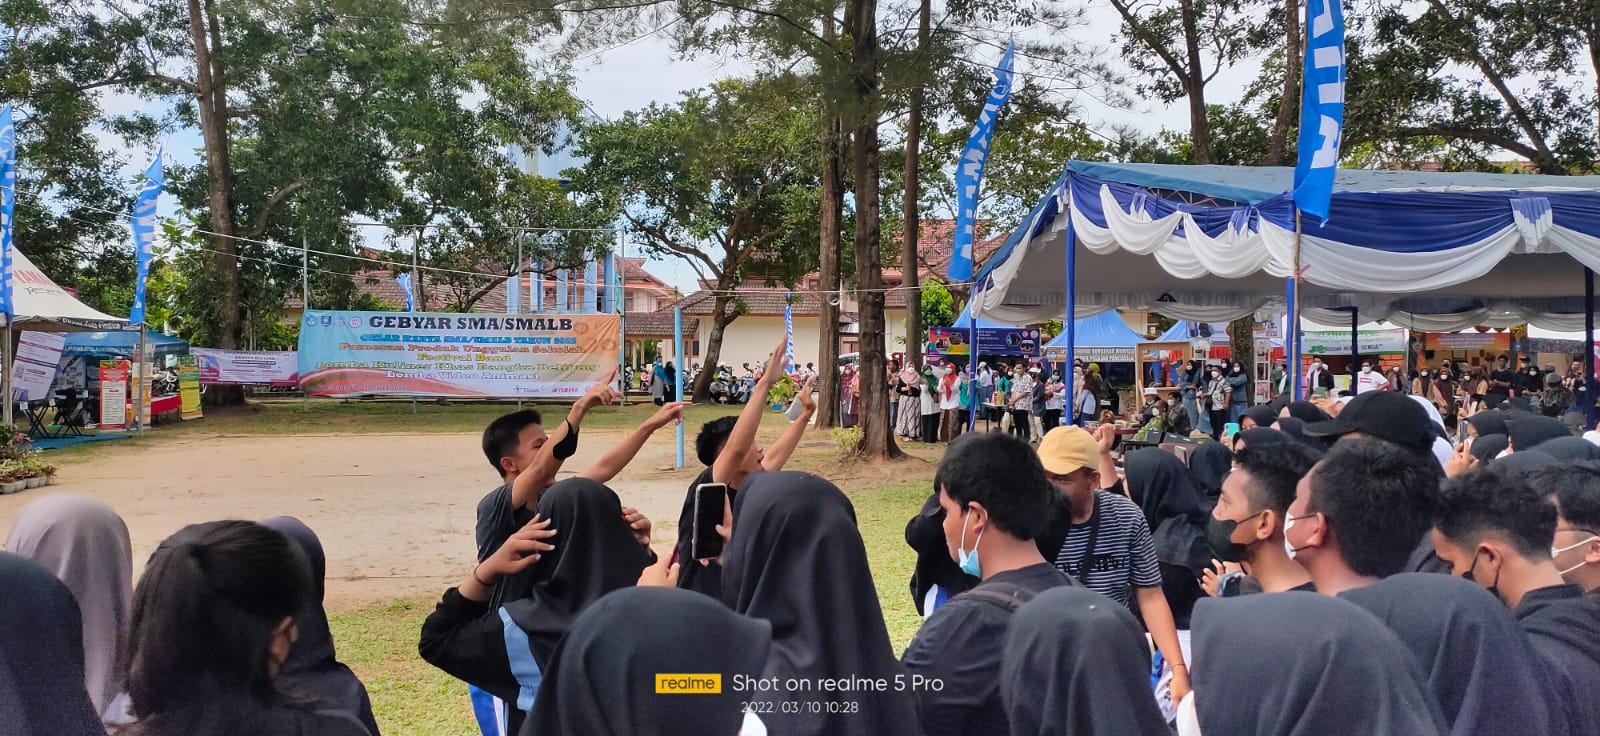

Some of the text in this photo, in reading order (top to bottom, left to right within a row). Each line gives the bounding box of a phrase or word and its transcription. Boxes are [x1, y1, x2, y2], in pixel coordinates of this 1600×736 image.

[369, 316, 573, 331] GEBYAR SMA/SMALB
[339, 342, 586, 354] Pameran Produk Unggulan Sekolah
[417, 354, 512, 362] Festival Band
[316, 361, 600, 373] Lomba Kuliner Khas Bangka Belitung
[384, 370, 437, 379] Lomba
[480, 371, 540, 380] Animasi
